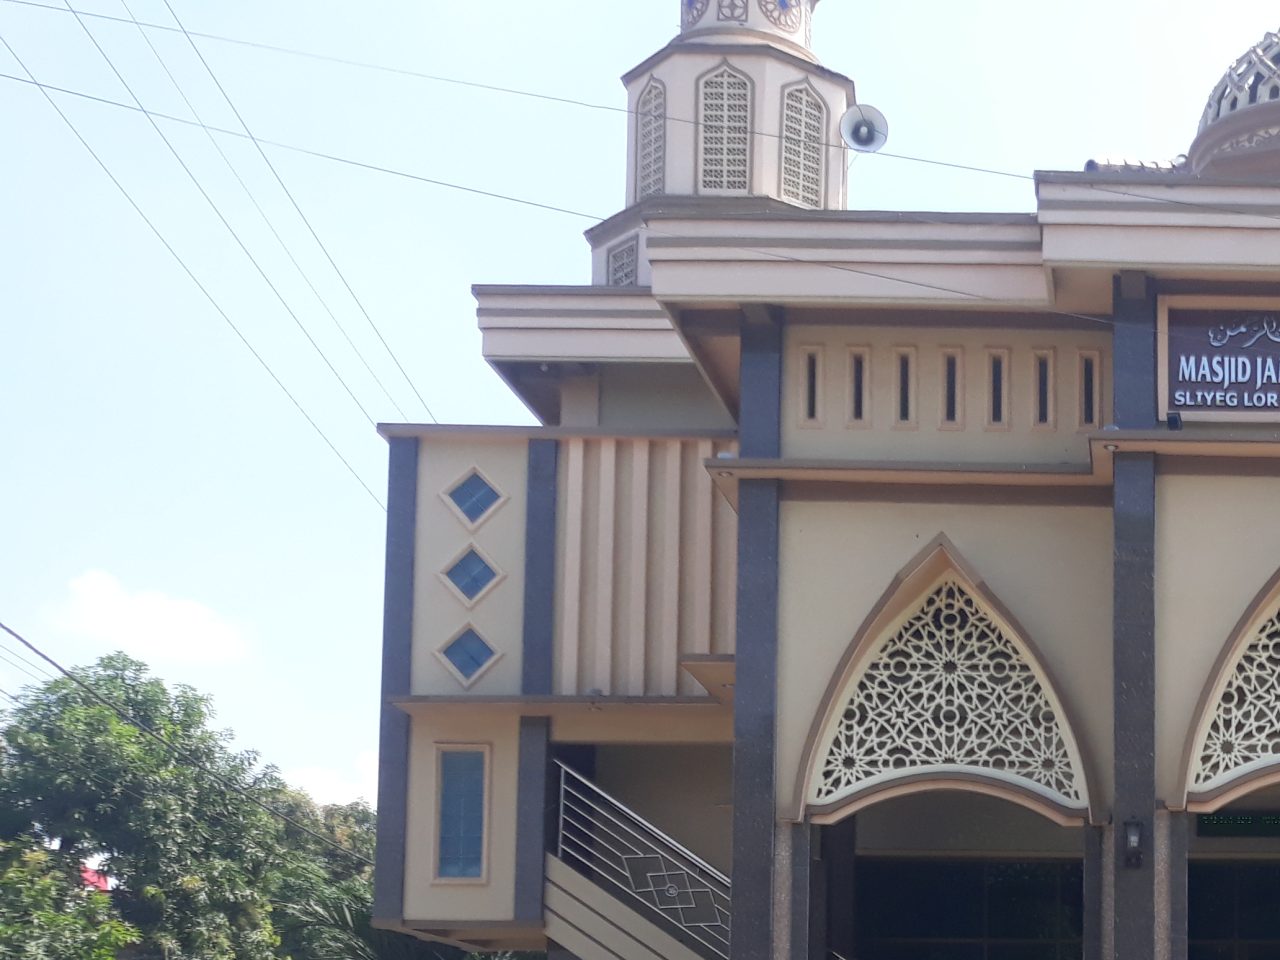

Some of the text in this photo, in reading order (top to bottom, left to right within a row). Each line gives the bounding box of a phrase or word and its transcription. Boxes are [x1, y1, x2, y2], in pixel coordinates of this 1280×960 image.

[1179, 355, 1251, 388] MASJID
[1174, 390, 1238, 406] SLIYEG
[1243, 391, 1279, 407] LOR
